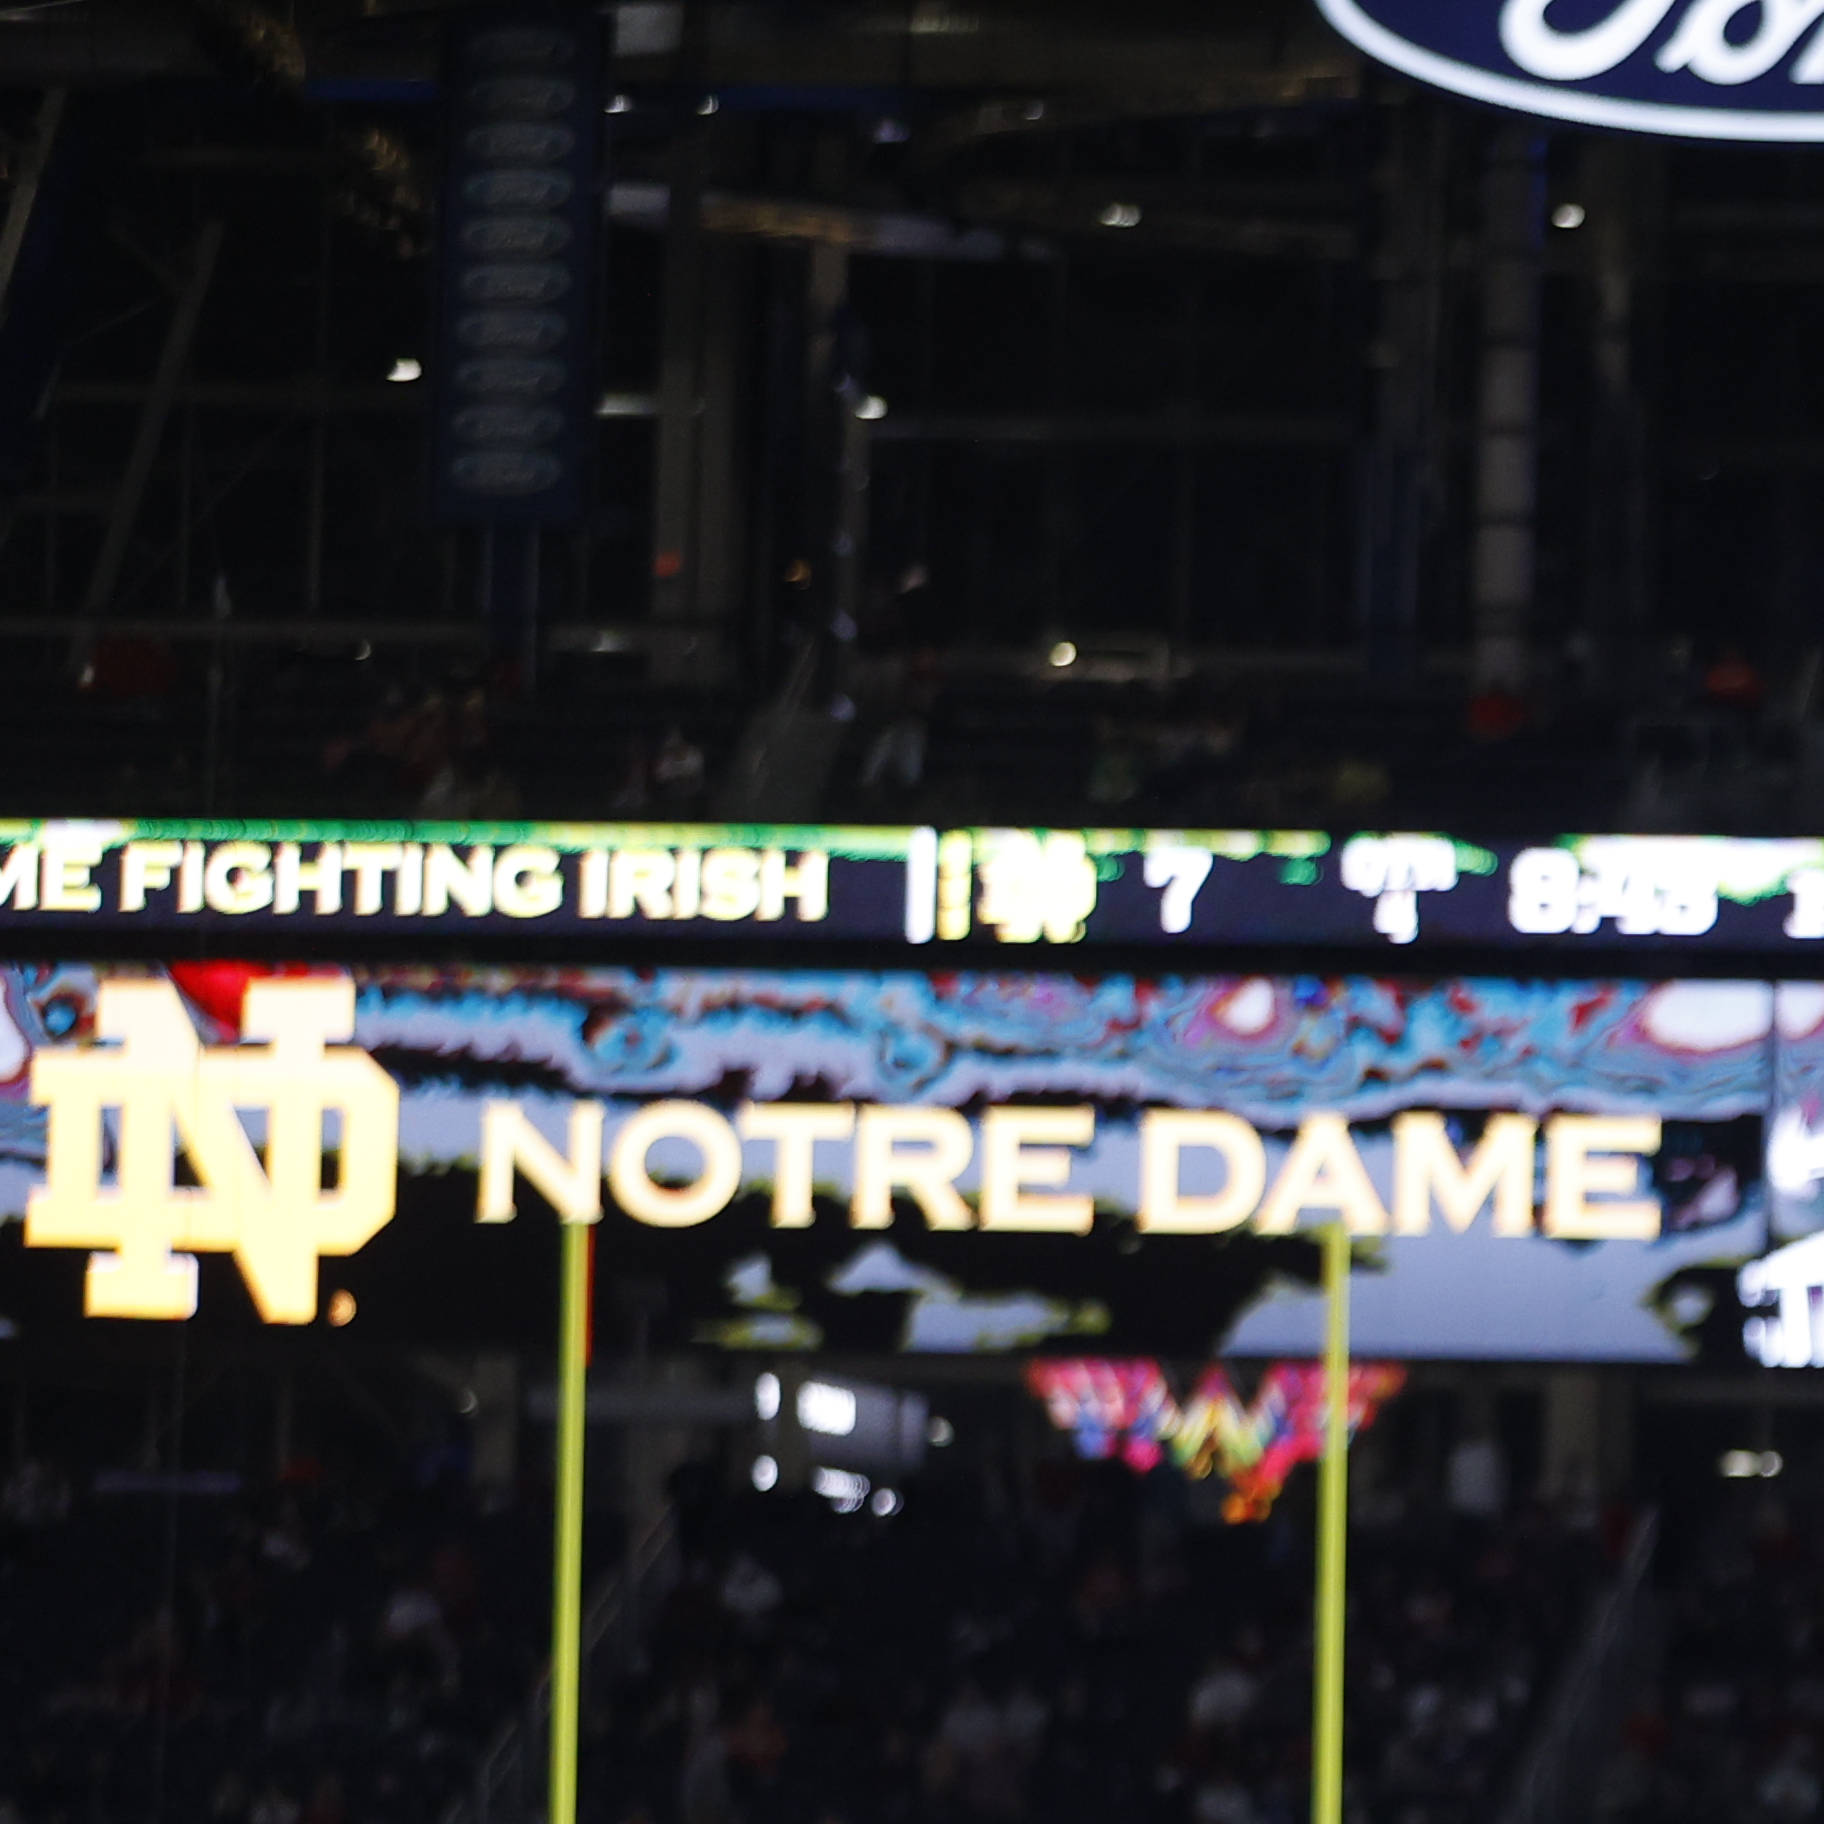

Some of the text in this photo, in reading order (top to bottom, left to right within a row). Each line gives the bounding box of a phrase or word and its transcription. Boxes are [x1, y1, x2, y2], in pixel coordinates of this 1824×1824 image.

[118, 839, 564, 918] FIGHTING
[577, 846, 831, 924] IRISH
[1143, 845, 1214, 934] 7
[475, 1099, 1663, 1241] NOTRE DAME
